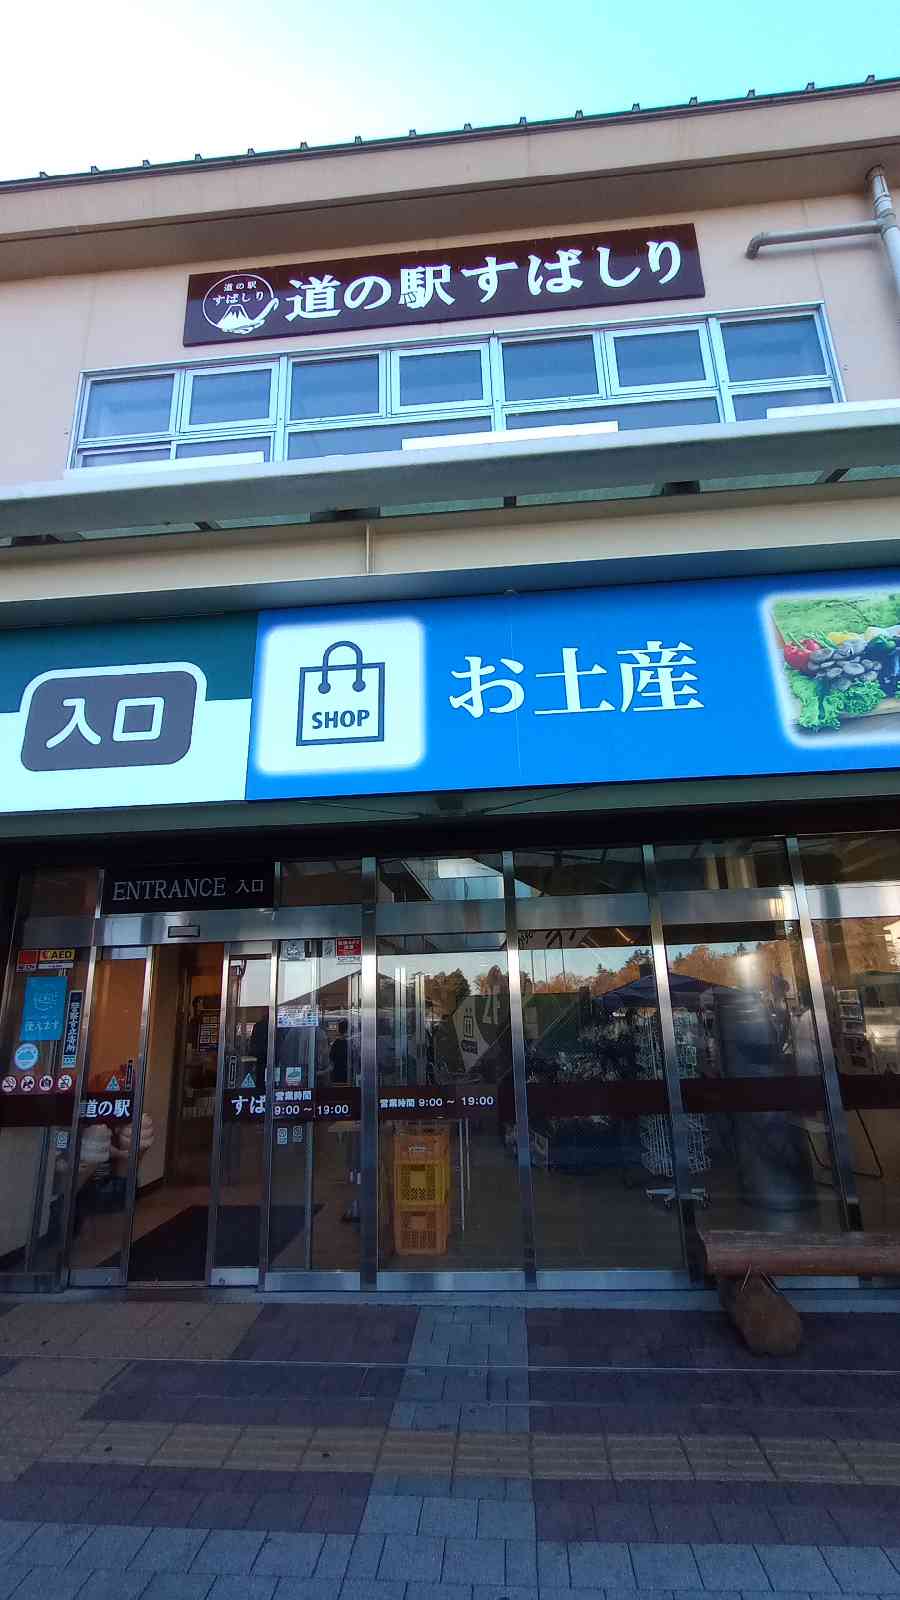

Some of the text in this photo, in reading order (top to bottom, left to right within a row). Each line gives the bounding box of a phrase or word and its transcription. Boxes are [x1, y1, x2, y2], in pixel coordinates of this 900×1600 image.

[224, 280, 257, 292] 道の駅
[284, 239, 682, 323] 道の駅すばしり
[212, 291, 264, 306] すばしり
[448, 640, 705, 719] お土産
[45, 696, 165, 750] 入口
[311, 709, 371, 730] SHOP
[112, 877, 264, 901] ENTRANCE 入口
[51, 950, 72, 959] AED
[273, 1104, 300, 1116] 9:00
[318, 1104, 350, 1115] 19:00
[418, 1097, 443, 1107] 9:00
[461, 1096, 494, 1106] 19:00
